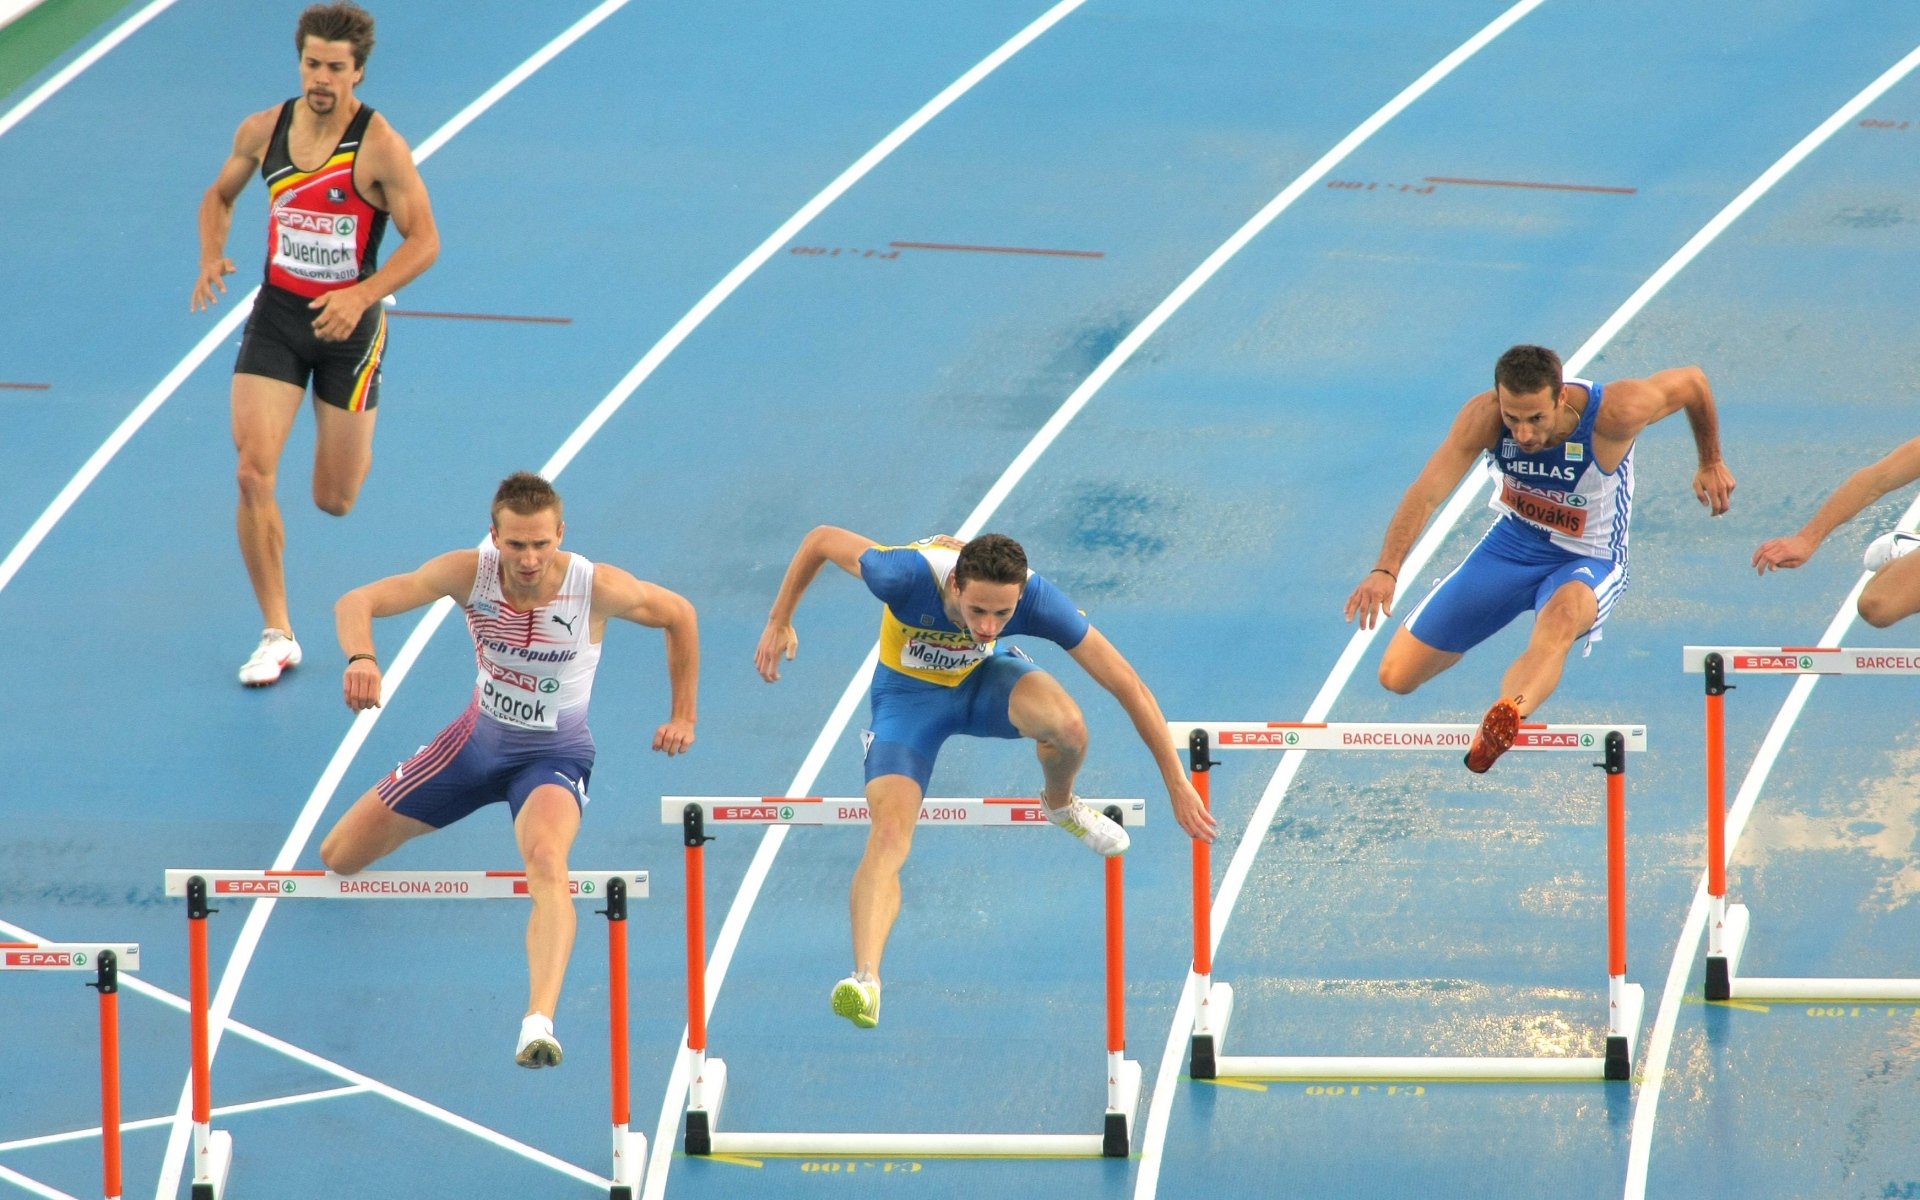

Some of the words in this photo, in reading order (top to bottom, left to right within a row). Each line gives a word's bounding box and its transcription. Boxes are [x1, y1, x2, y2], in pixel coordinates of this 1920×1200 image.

[276, 211, 332, 232] SPAR
[281, 233, 350, 266] Duerinck
[335, 268, 356, 280] 2010
[1506, 460, 1575, 481] HELLAS
[510, 647, 577, 663] republic
[909, 644, 984, 669] Melnyk
[1747, 658, 1796, 667] SPAR
[480, 659, 536, 690] SPAR
[1231, 733, 1282, 743] SPAR
[1343, 733, 1434, 745] BARCELONA
[1437, 733, 1470, 745] 2010
[1527, 735, 1578, 744] SPAR
[726, 808, 777, 818] SPAR
[932, 808, 967, 820] 2010
[228, 882, 279, 892] SPAR
[340, 881, 432, 893] BARCELONA
[434, 881, 469, 893] 2010
[19, 954, 70, 964] SPAR
